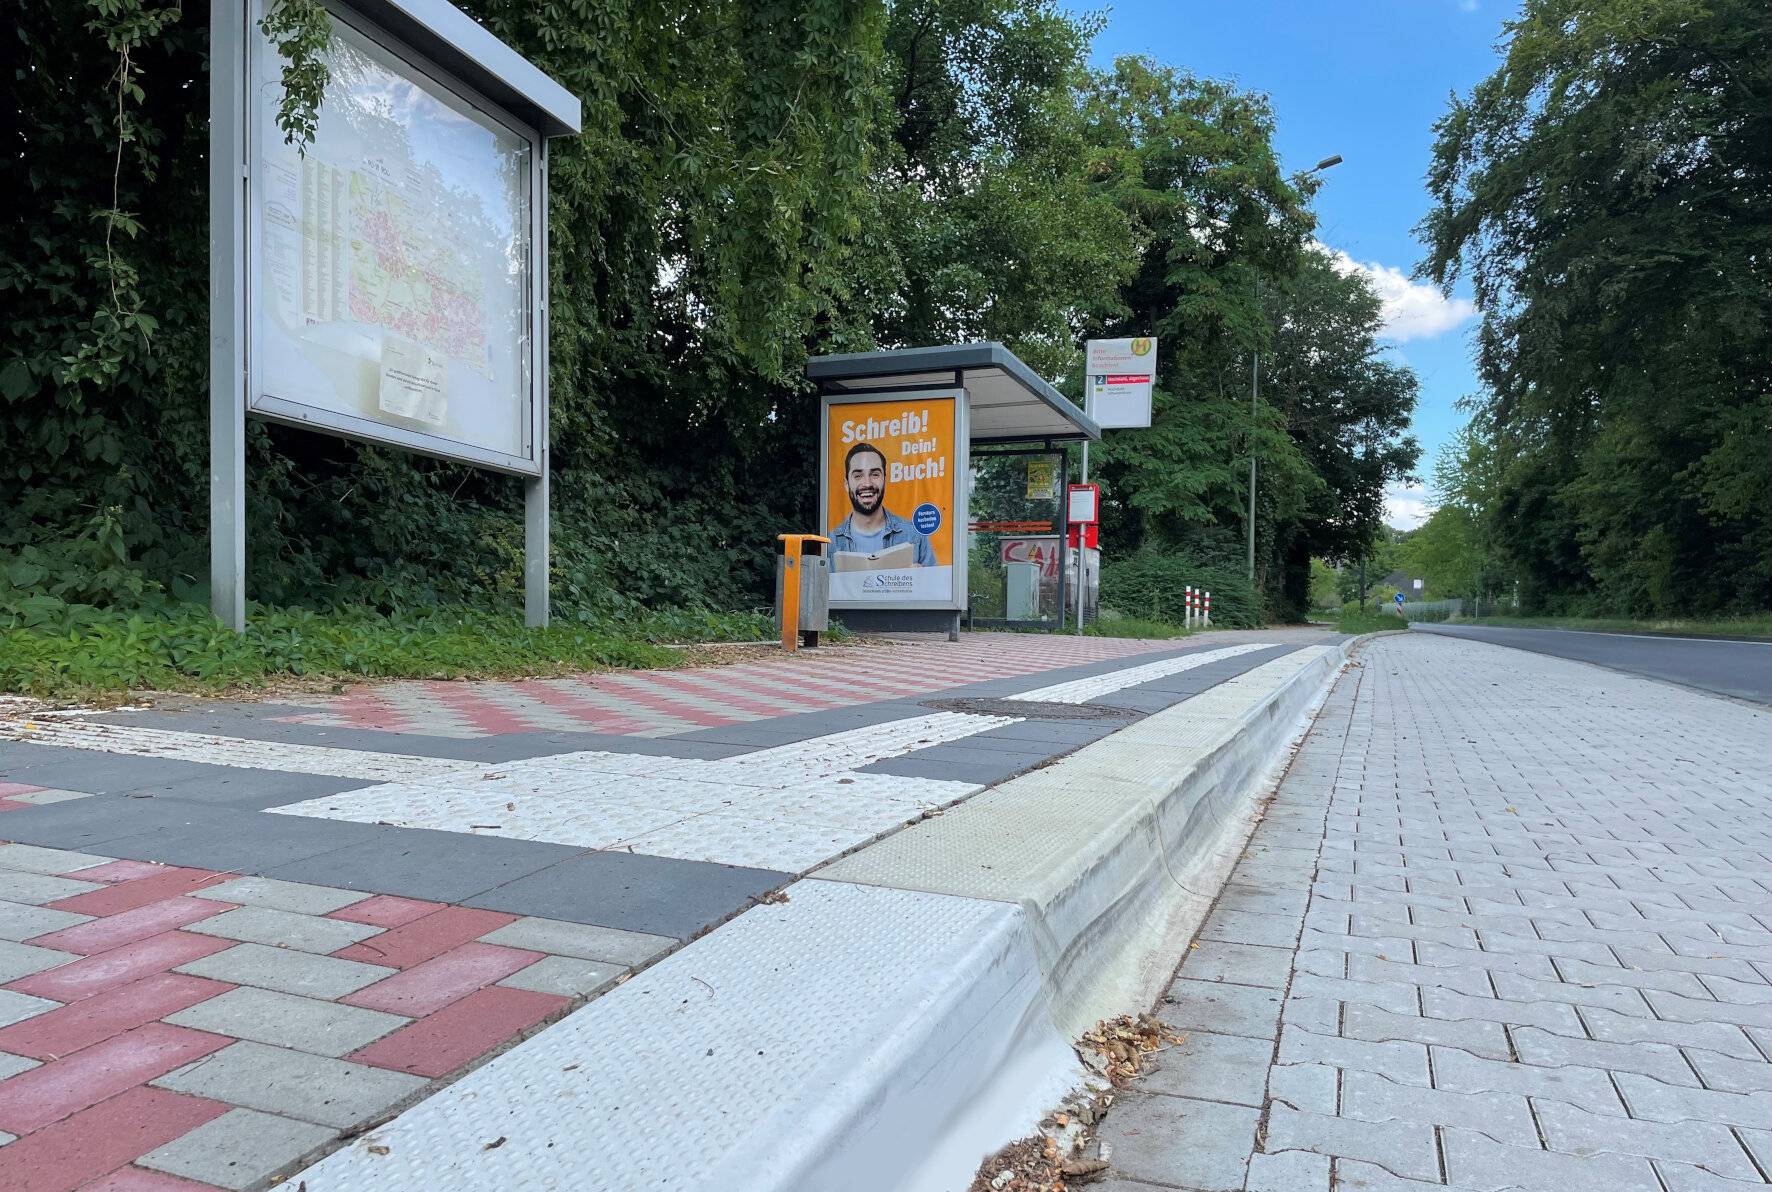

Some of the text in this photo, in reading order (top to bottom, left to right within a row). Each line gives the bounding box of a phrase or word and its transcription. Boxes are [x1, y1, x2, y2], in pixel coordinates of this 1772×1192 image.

[1097, 375, 1104, 384] 2
[842, 410, 928, 443] Schreib!
[902, 437, 937, 455] Dein!
[890, 456, 945, 483] Buch!
